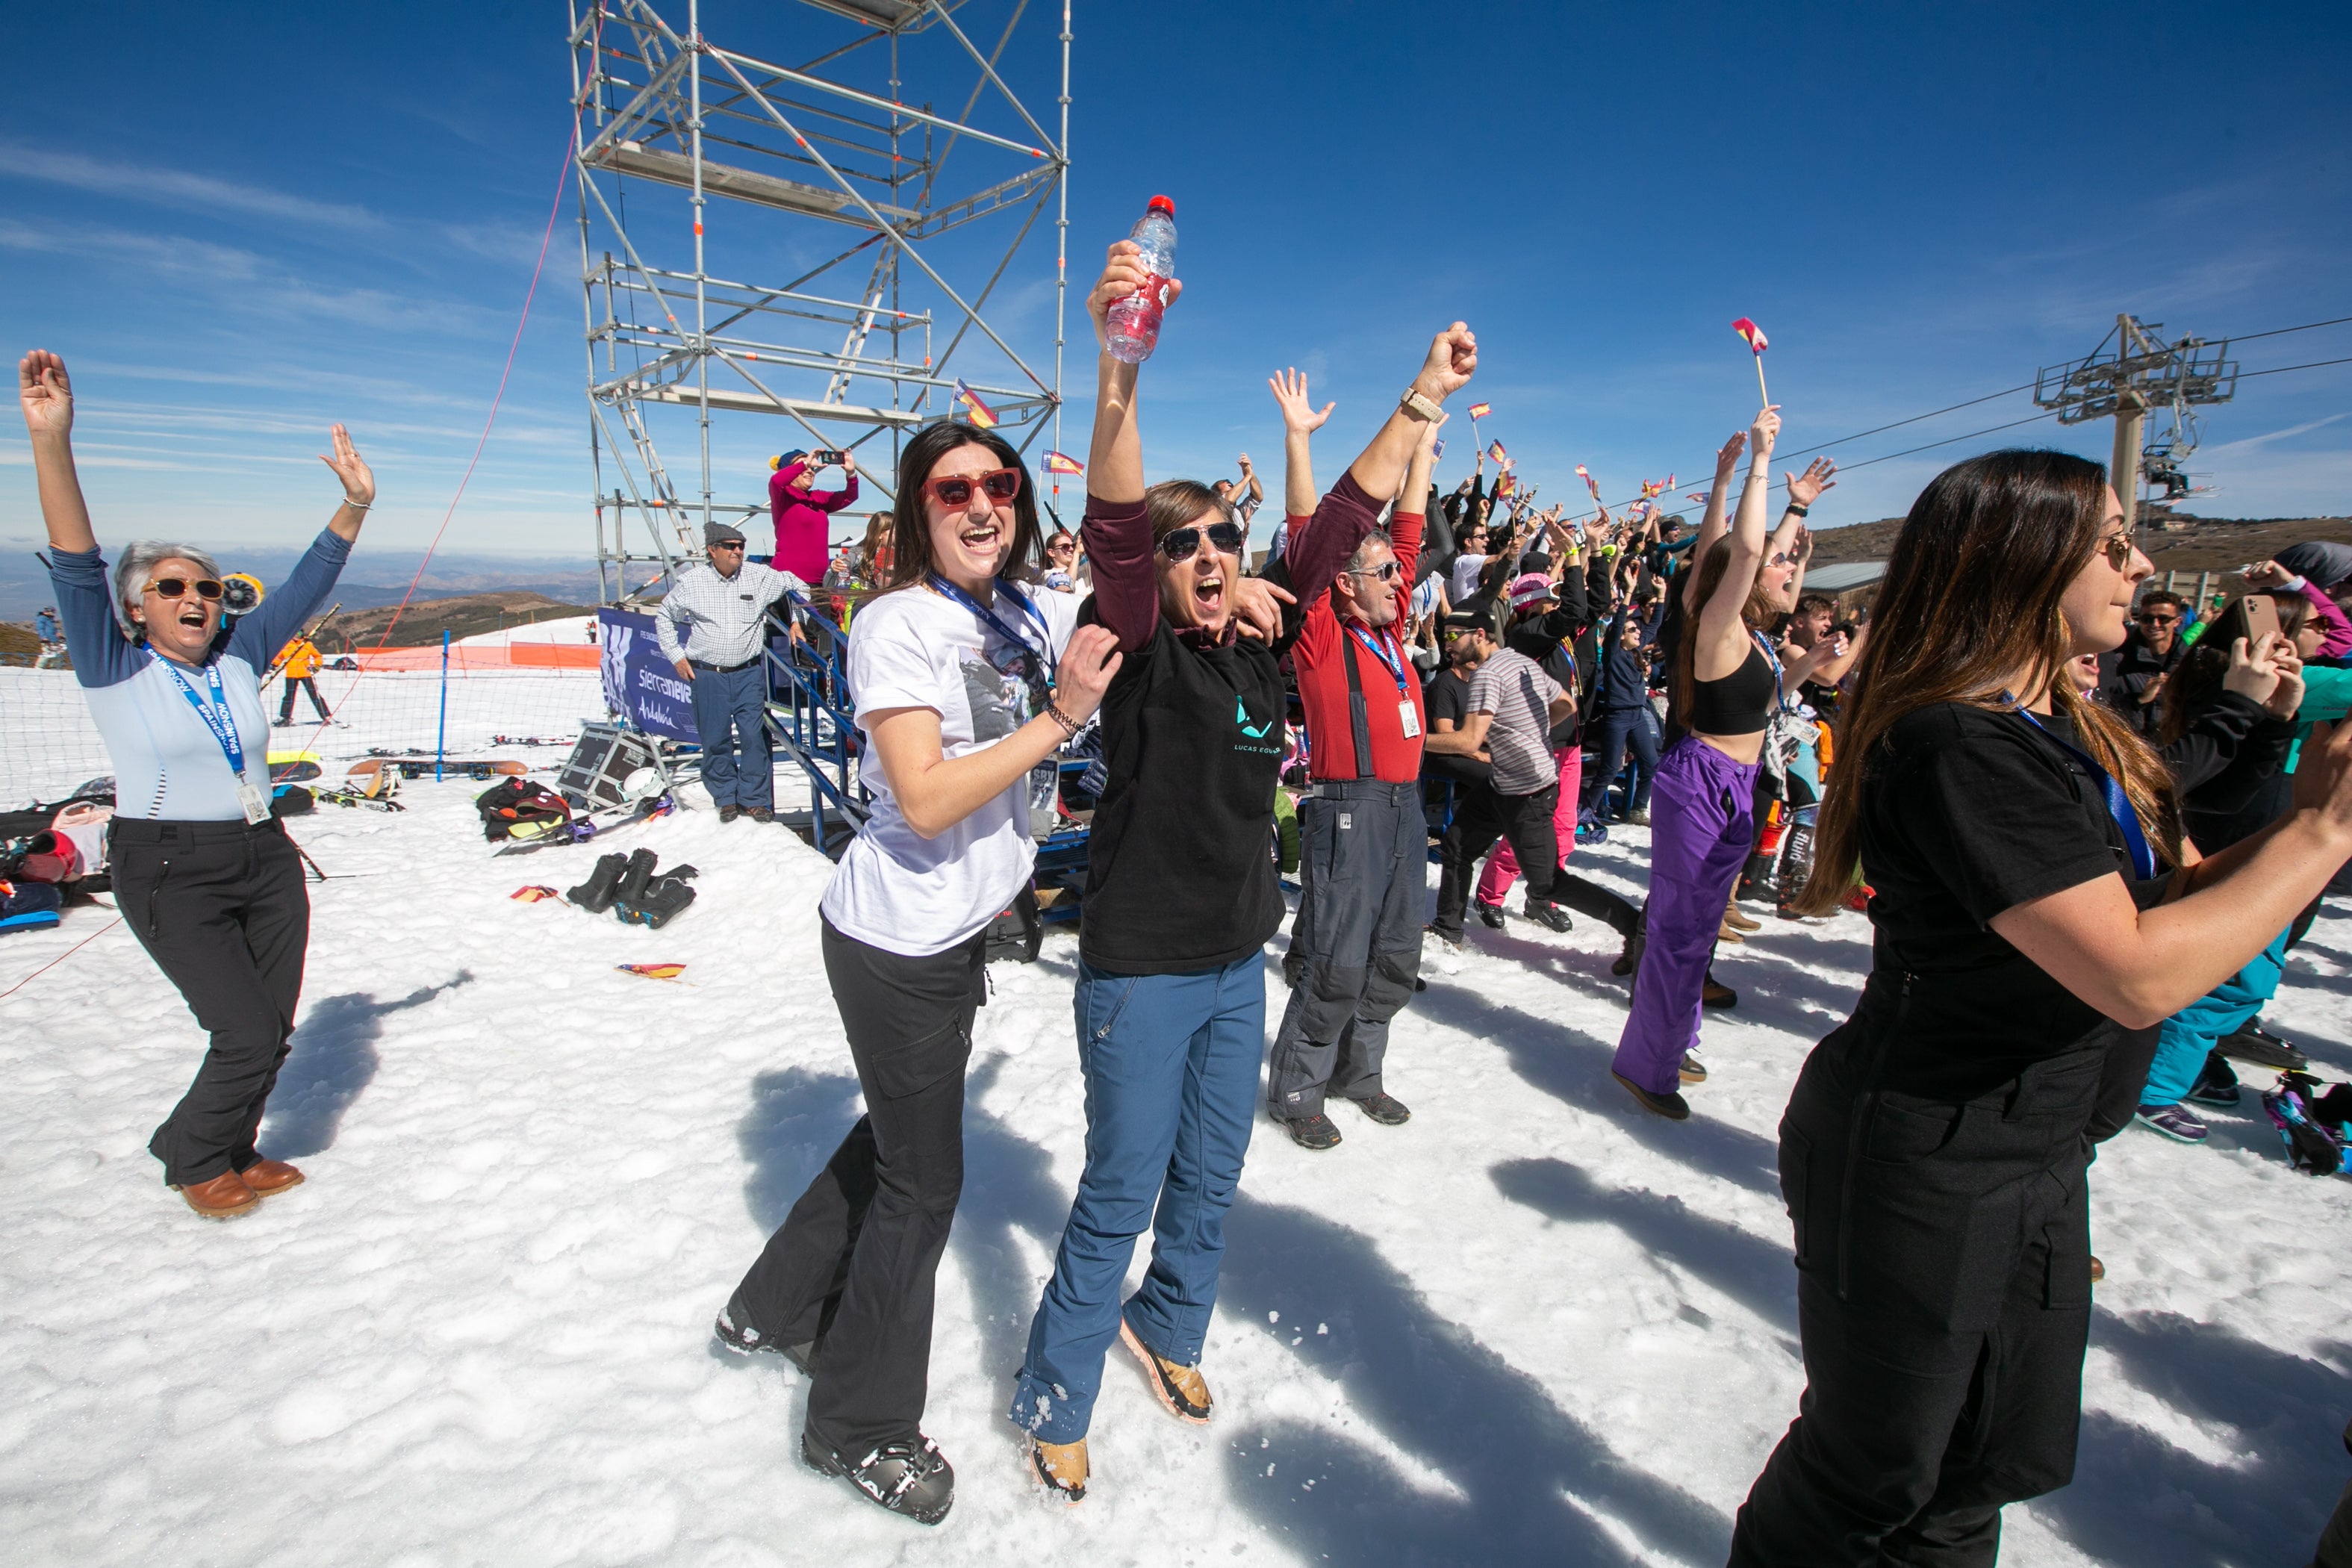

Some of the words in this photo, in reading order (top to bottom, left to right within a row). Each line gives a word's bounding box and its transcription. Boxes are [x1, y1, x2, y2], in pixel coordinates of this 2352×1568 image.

[146, 648, 192, 693] SPAINSNOW
[638, 665, 692, 704] sierraneva
[216, 702, 240, 755] SPAINSNOW
[1790, 830, 1810, 865] fluid
